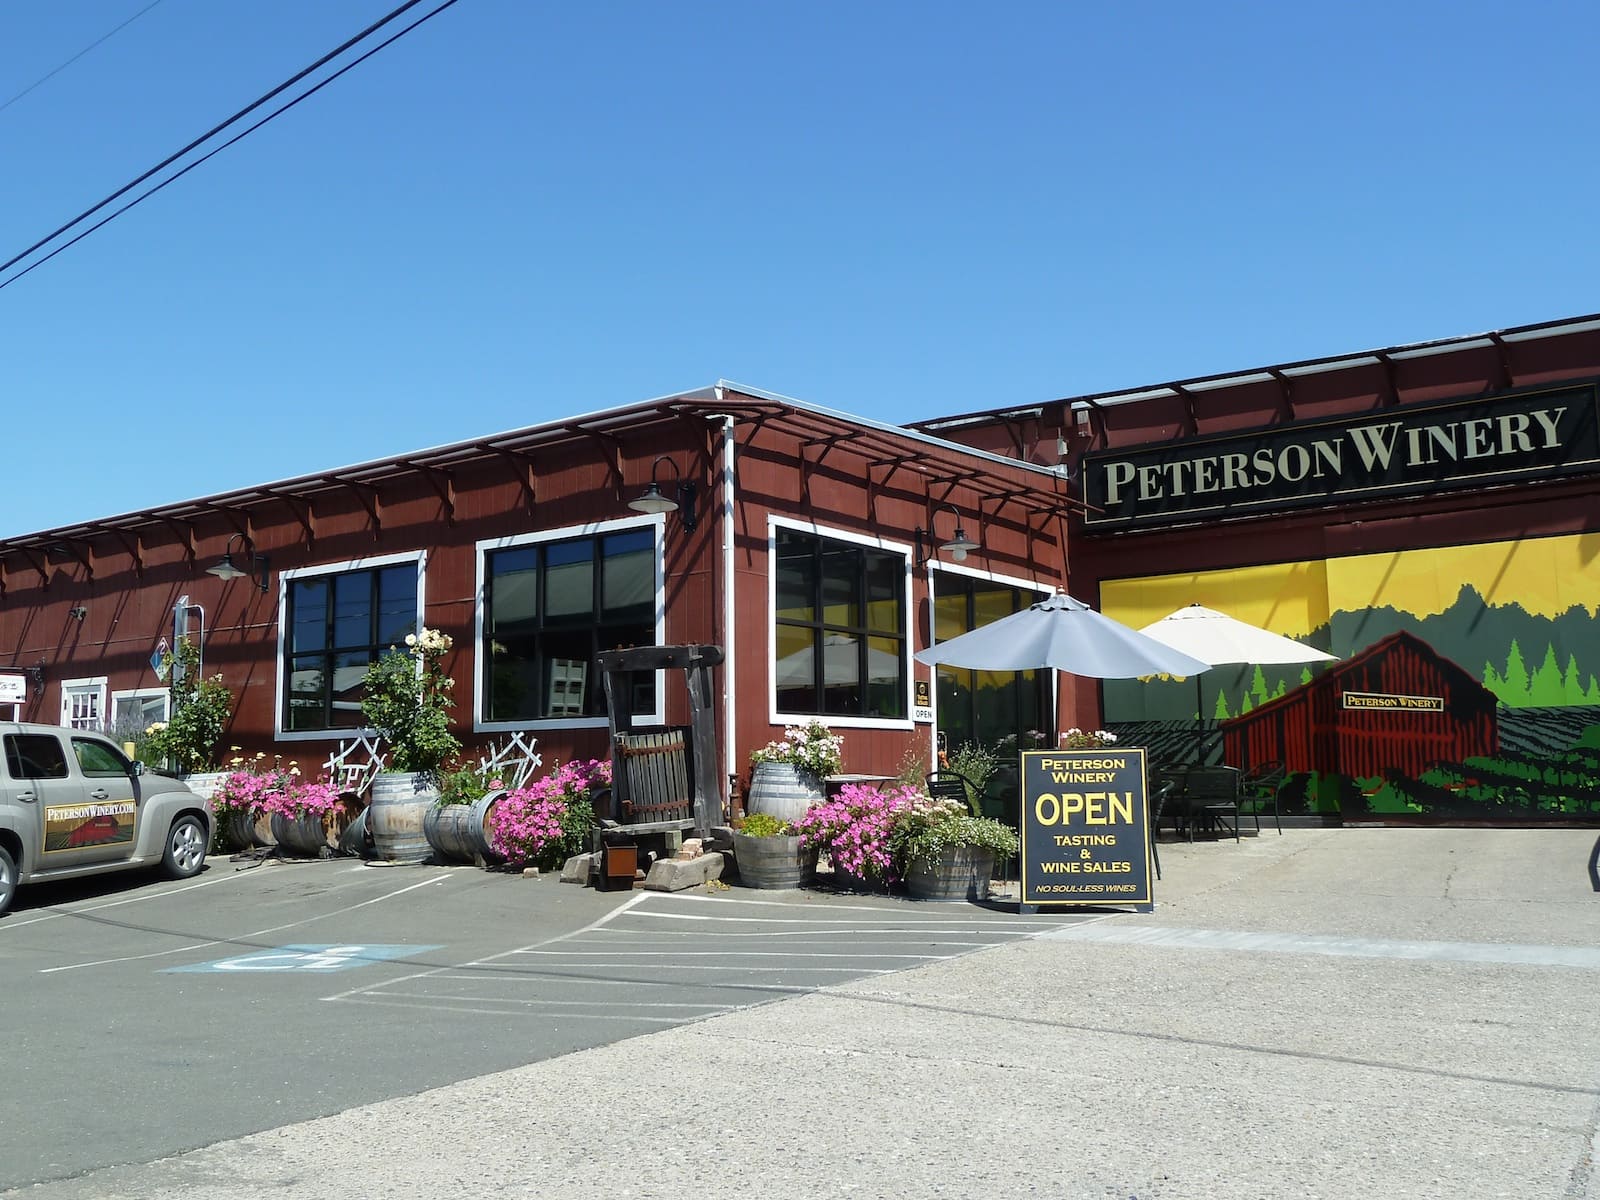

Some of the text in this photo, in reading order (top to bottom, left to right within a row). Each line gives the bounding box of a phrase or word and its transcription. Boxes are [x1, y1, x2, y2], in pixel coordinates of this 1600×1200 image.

[1103, 407, 1567, 504] PETERSON WINERY
[1347, 696, 1438, 708] PETERSON WINERY
[916, 710, 932, 718] OPEN
[1041, 759, 1125, 770] PETERSON
[1051, 772, 1115, 783] WINERY
[1035, 792, 1133, 825] OPEN
[1053, 835, 1116, 846] TASTING
[1080, 849, 1091, 859] &
[1041, 862, 1131, 873] WINE SALES
[1052, 884, 1104, 893] SOUL-LESS
[1105, 884, 1136, 892] WINES
